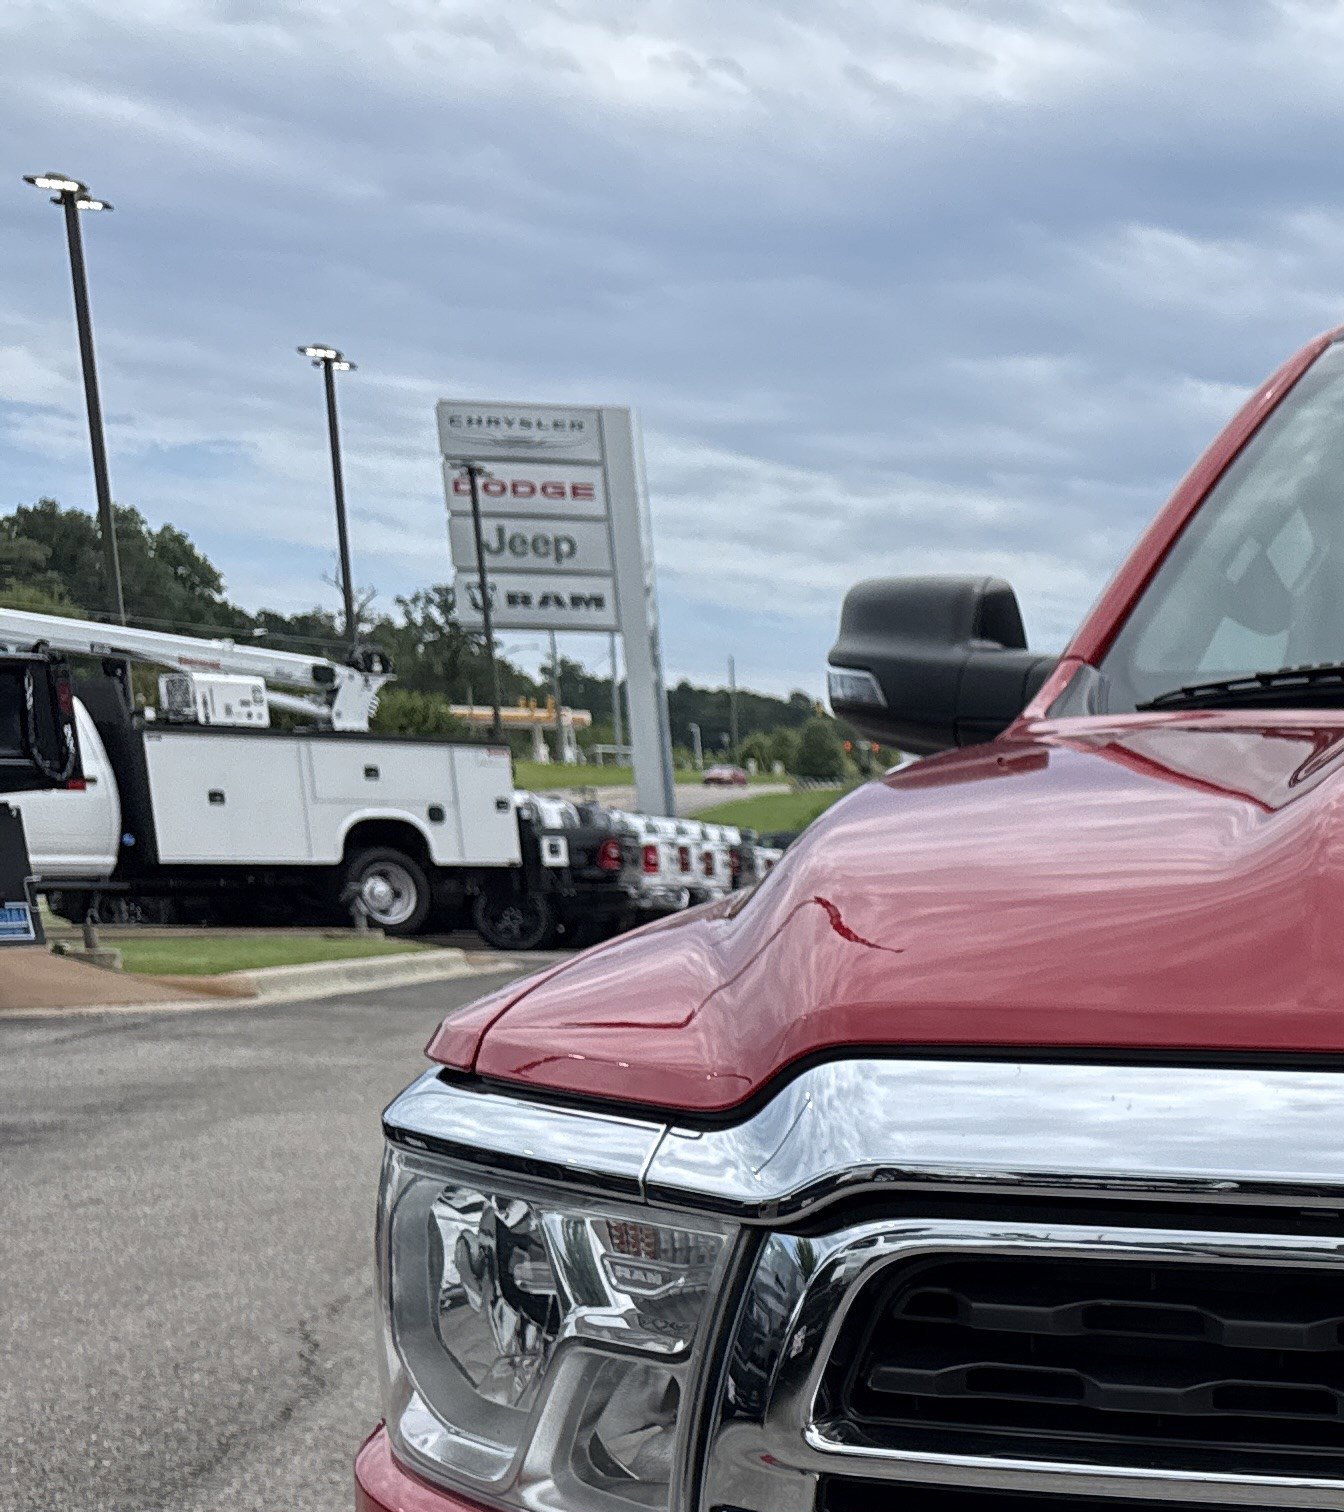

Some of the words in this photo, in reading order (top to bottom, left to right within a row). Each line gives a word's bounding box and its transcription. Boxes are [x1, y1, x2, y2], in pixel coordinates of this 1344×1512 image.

[448, 414, 585, 432] CHRYSLER
[453, 478, 595, 500] DODGE
[482, 523, 577, 564] Jeep
[506, 590, 605, 610] RAM
[614, 1265, 663, 1285] RAM
